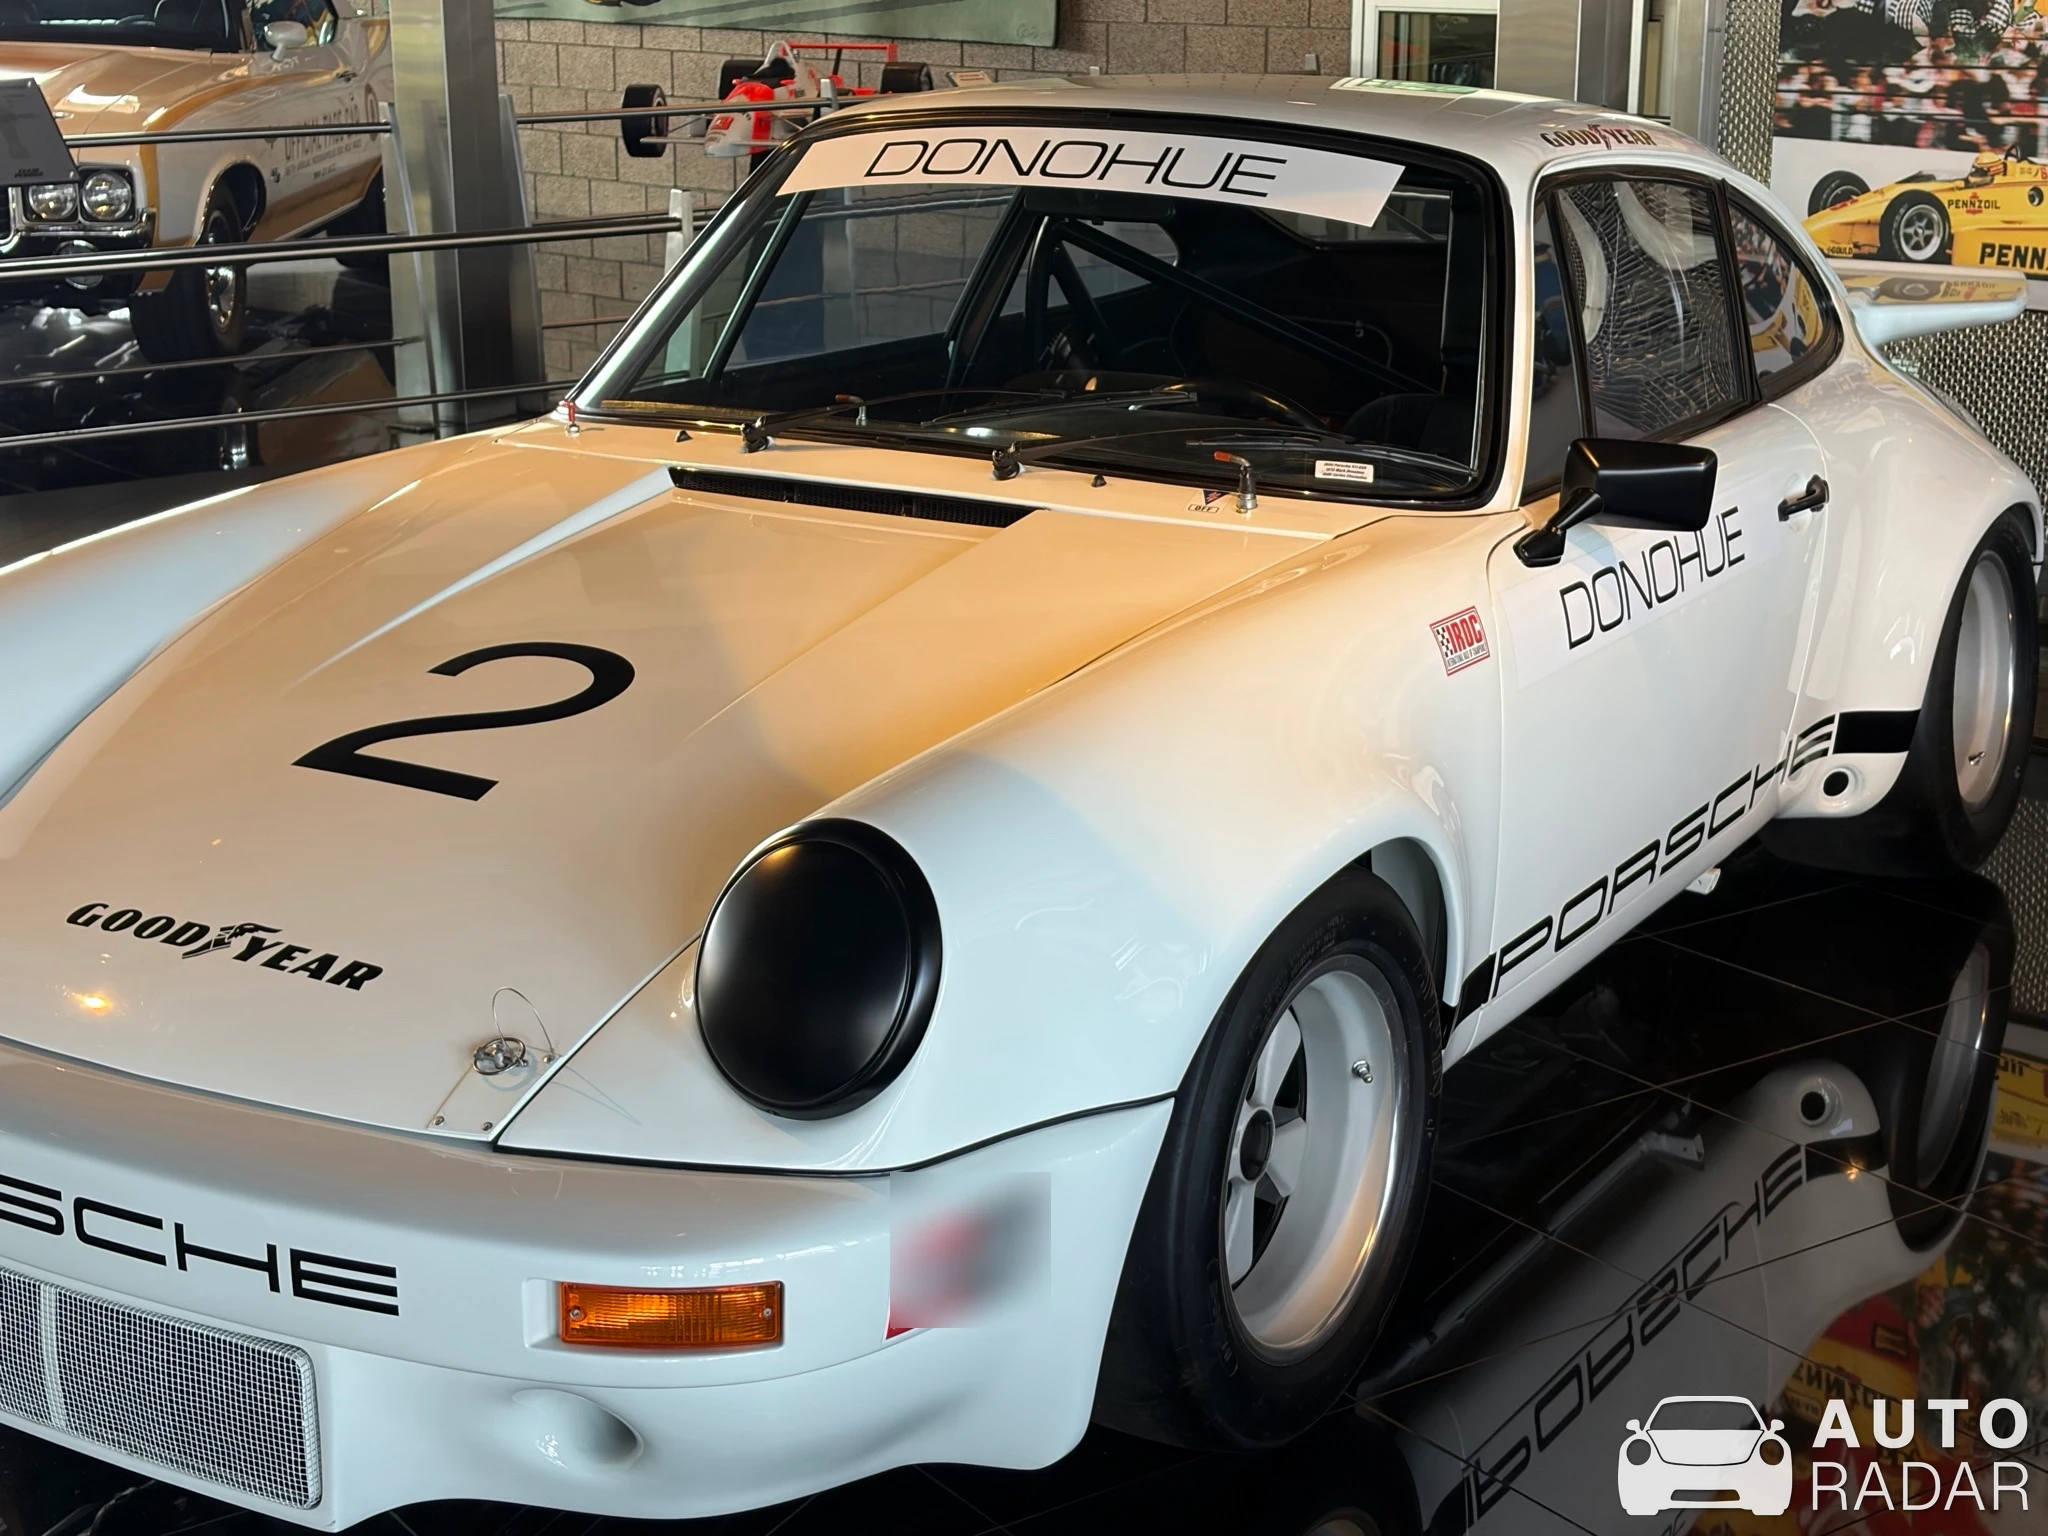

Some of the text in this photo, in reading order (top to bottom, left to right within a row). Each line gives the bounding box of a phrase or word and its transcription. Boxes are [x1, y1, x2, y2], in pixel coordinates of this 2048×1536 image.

[864, 138, 1287, 198] DONOHUE
[1947, 199, 2001, 209] PENNZOIL
[1979, 242, 2048, 270] PENN
[1559, 506, 1745, 650] DONOHUE
[1445, 614, 1483, 653] IROC
[290, 641, 636, 802] 2
[1492, 714, 1837, 1001] PORSCHE
